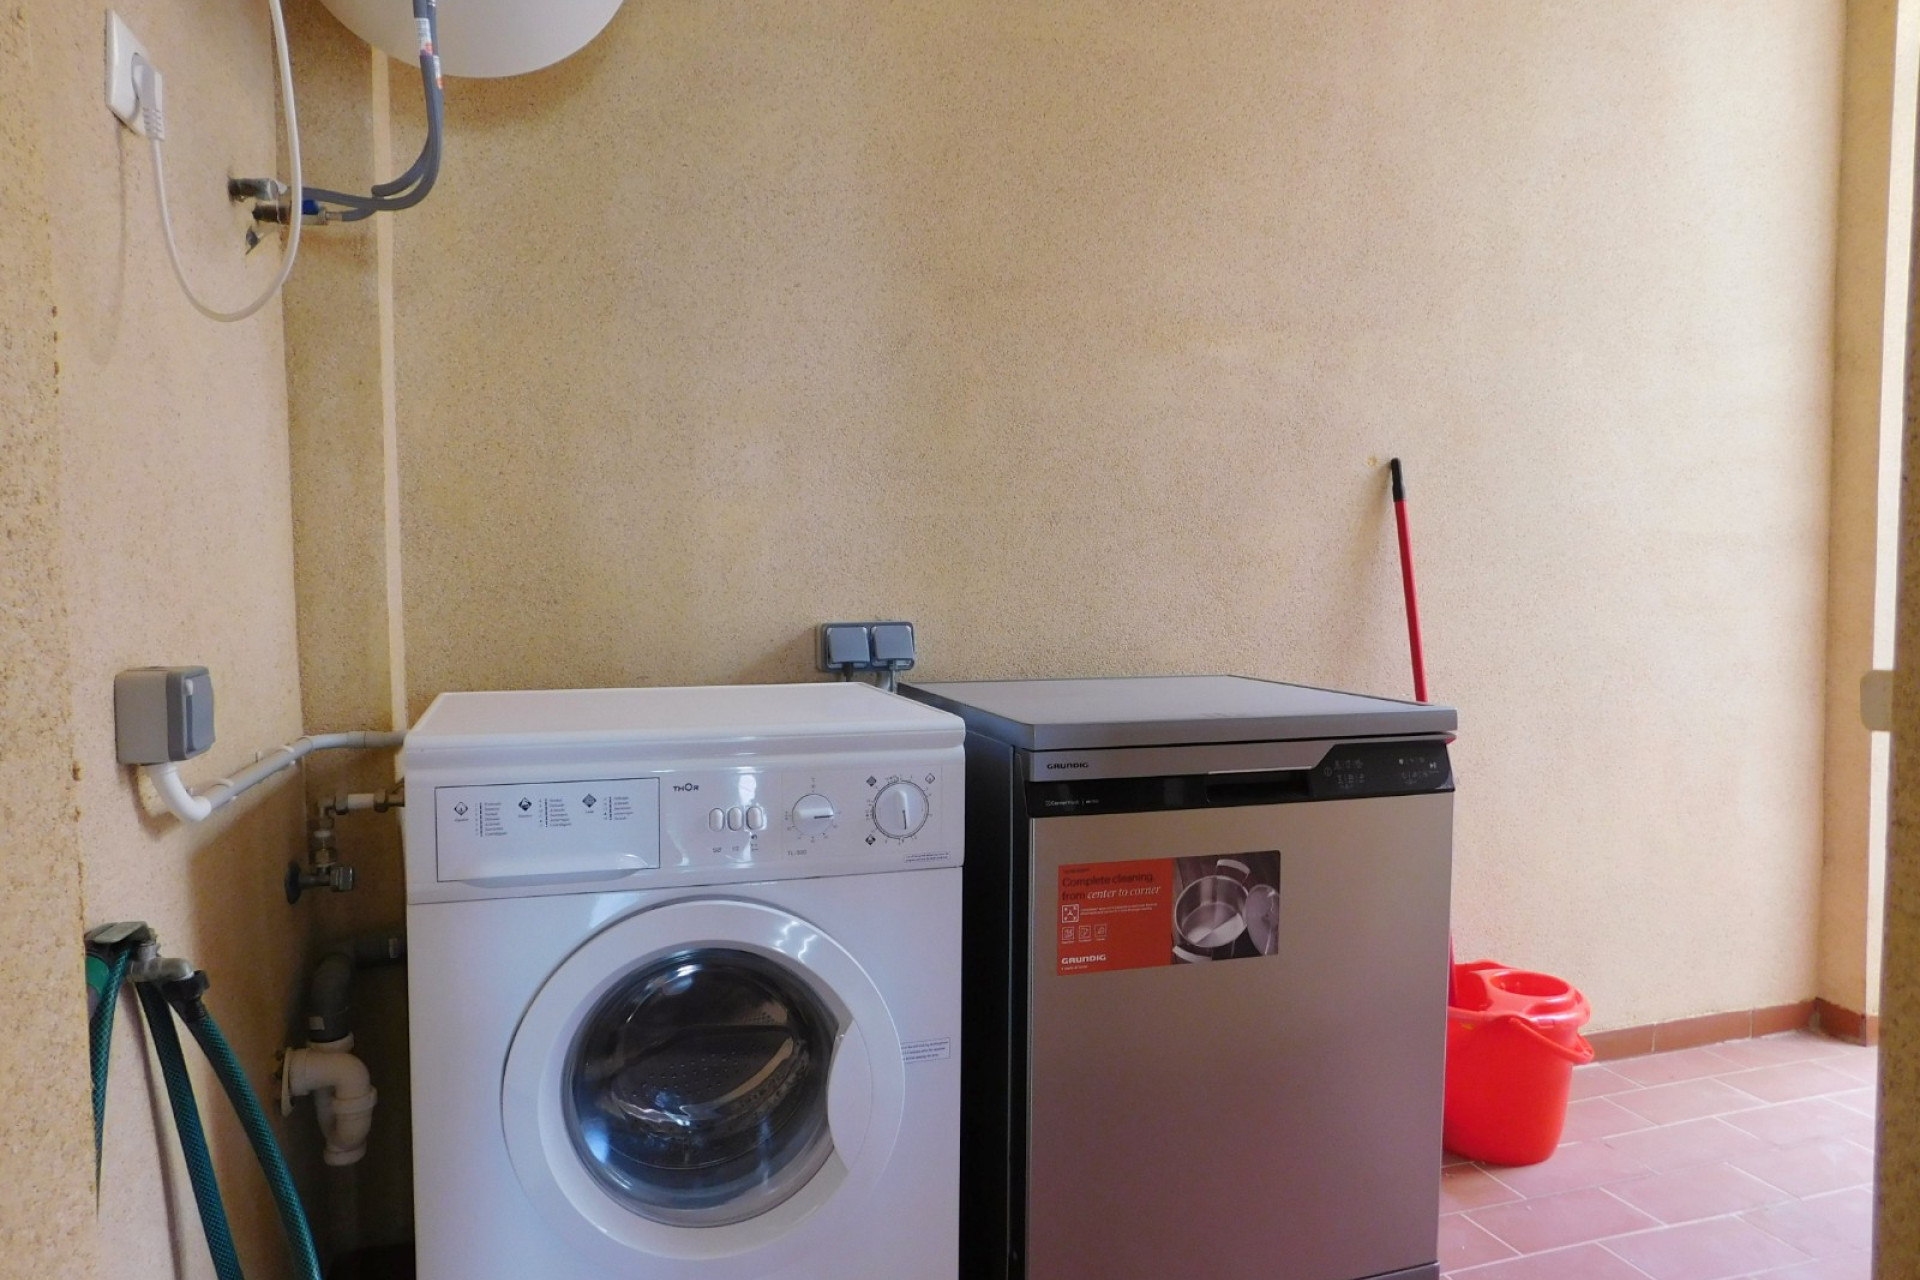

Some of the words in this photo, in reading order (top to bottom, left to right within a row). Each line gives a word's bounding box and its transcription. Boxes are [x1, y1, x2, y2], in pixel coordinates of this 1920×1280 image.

[1046, 761, 1089, 769] GRUNDIG
[673, 783, 699, 792] THOR
[1062, 873, 1111, 887] Complete
[1112, 872, 1154, 885] cleaning
[1062, 890, 1086, 900] from
[1087, 887, 1117, 899] center
[1118, 887, 1128, 896] to
[1129, 885, 1161, 897] corner
[1061, 954, 1107, 965] GRUNDIG
